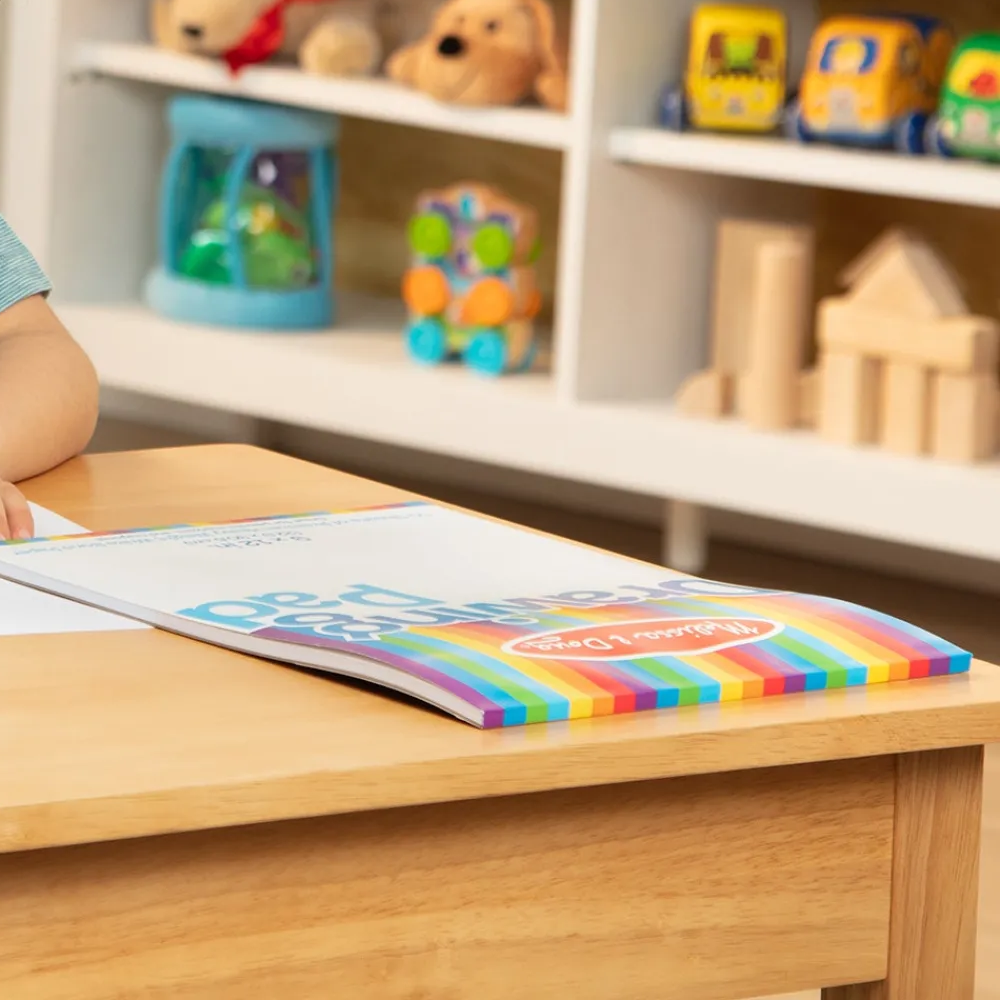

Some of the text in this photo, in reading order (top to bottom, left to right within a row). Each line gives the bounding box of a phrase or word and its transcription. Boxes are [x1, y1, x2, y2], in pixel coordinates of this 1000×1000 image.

[174, 583, 447, 631] Pad
[272, 578, 784, 640] Drawing
[527, 634, 614, 651] Doug
[633, 619, 760, 639] Melissa
